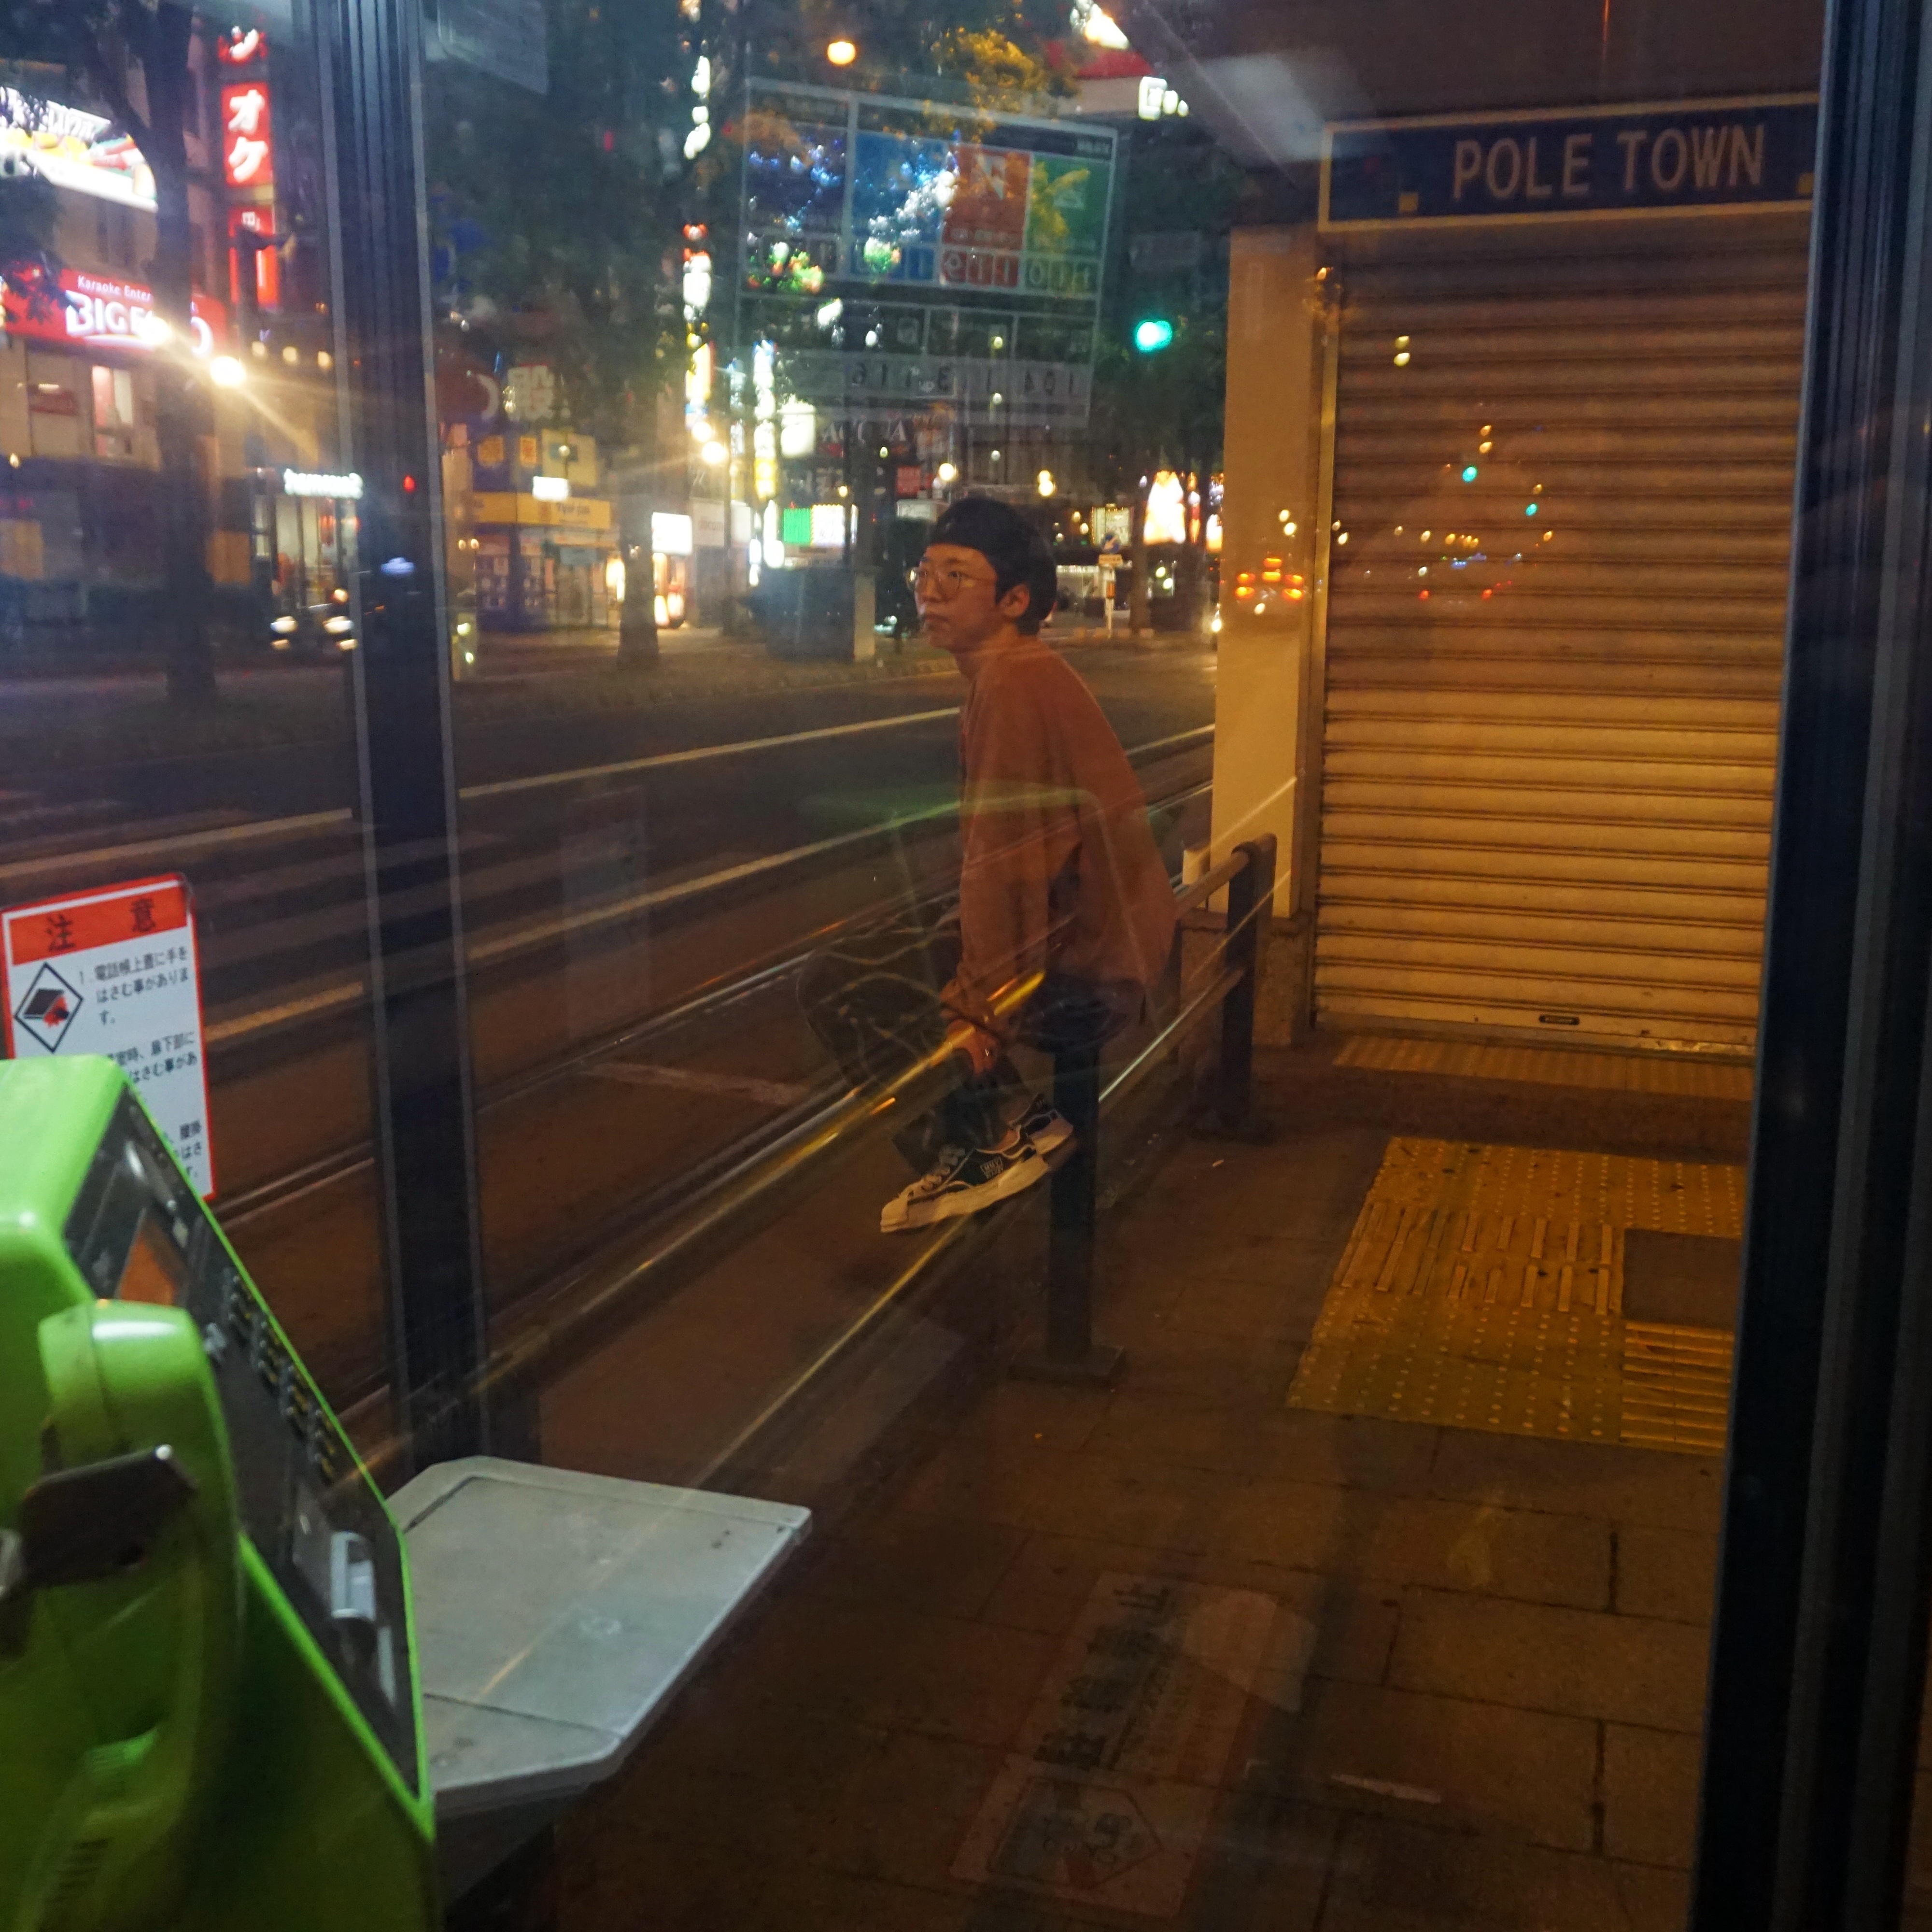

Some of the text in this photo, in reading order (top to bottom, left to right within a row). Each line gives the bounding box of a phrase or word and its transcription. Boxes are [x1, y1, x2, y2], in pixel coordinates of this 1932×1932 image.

[1453, 124, 1765, 202] POLE TOWN
[77, 274, 121, 295] Karaoke
[66, 289, 129, 337] BIG
